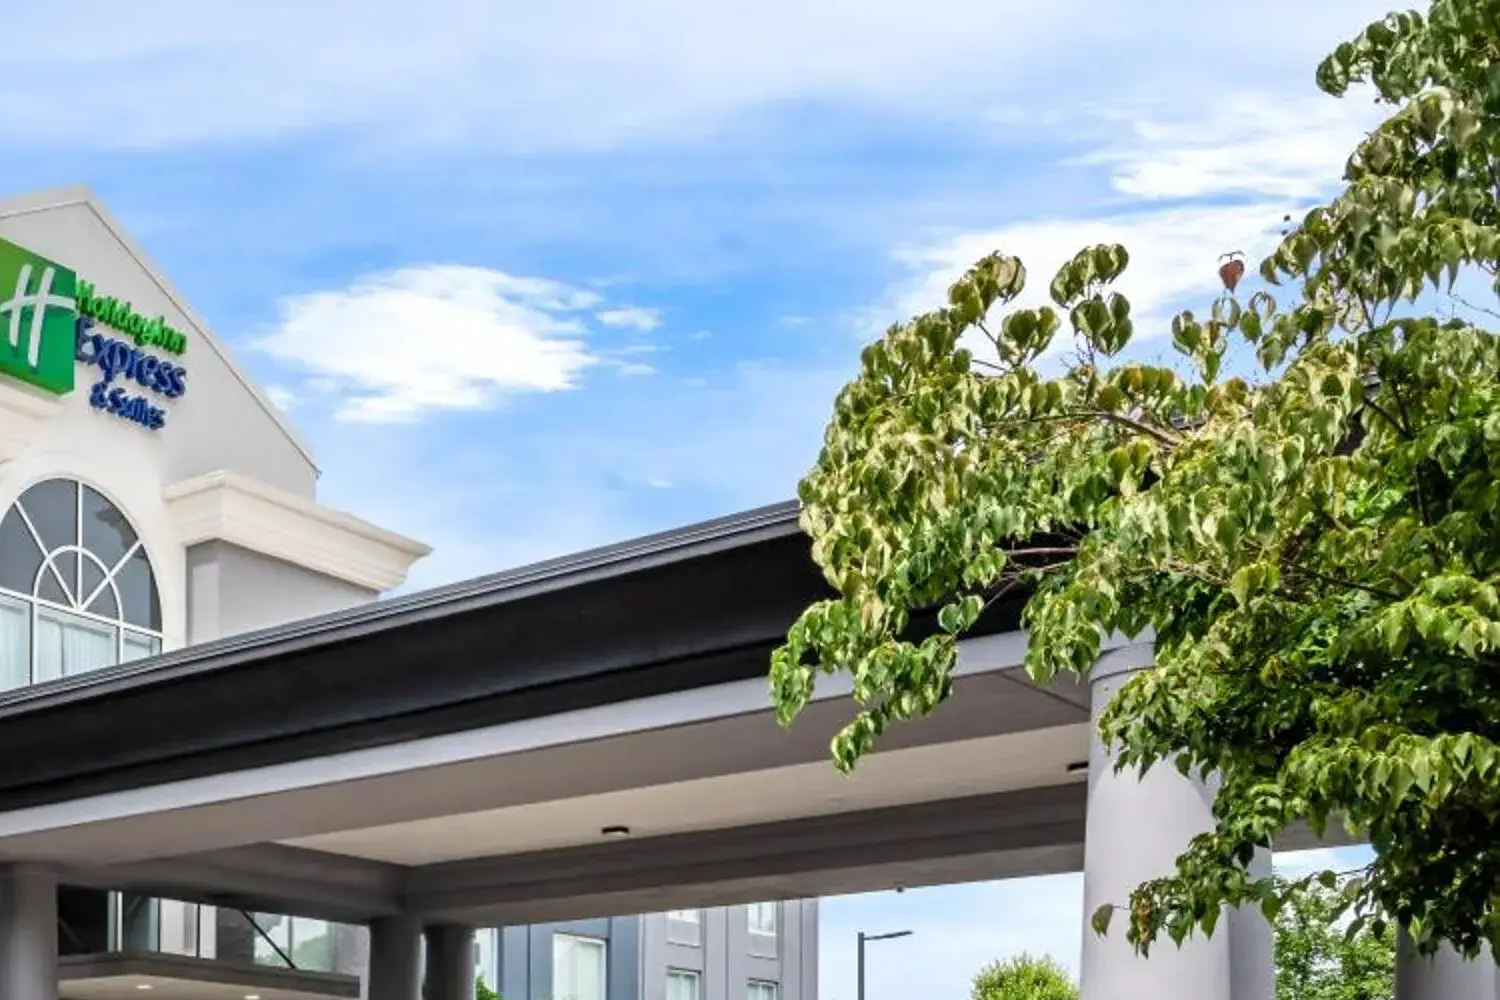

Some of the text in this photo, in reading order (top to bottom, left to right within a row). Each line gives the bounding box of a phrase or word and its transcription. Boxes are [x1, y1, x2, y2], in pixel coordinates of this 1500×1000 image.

[76, 278, 187, 355] Holiday Inn
[75, 315, 187, 398] Express
[89, 381, 166, 430] & Suites
